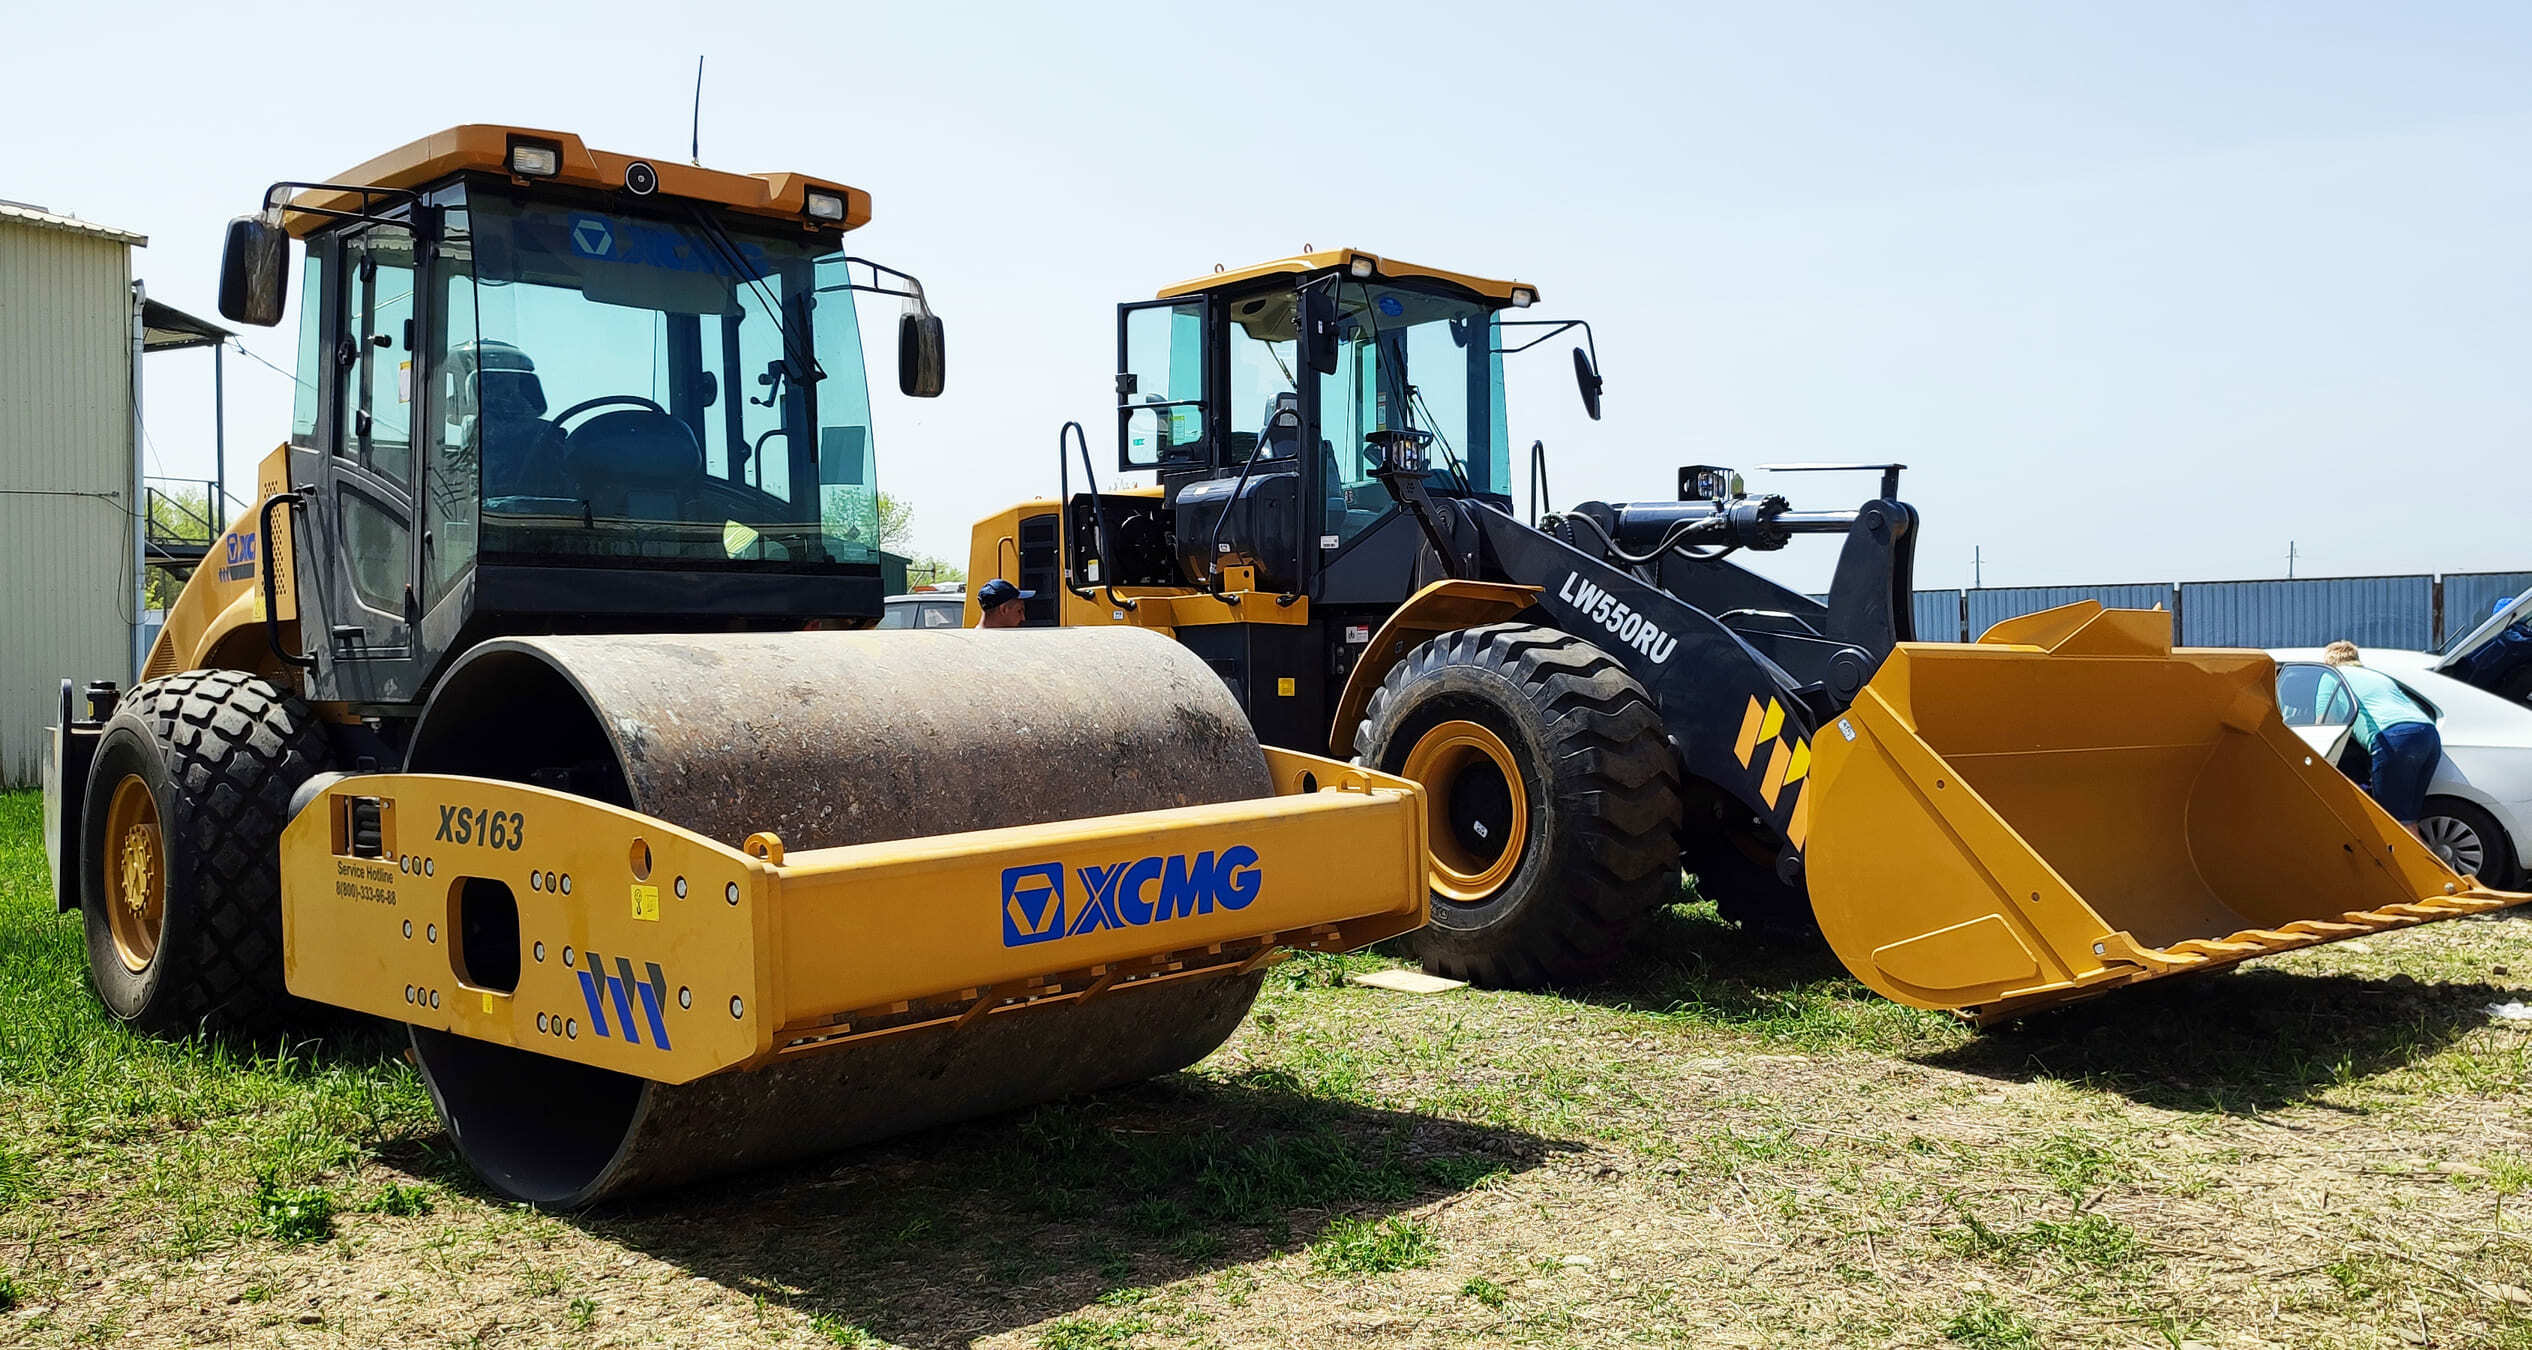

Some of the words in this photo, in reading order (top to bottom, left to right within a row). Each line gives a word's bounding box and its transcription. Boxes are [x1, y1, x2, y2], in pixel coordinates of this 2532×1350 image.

[239, 532, 256, 562] XC
[1558, 570, 1678, 664] LW550RU
[435, 804, 524, 852] XS163
[337, 860, 365, 879] Service
[366, 865, 393, 884] Hotline
[1066, 845, 1262, 937] XCMG
